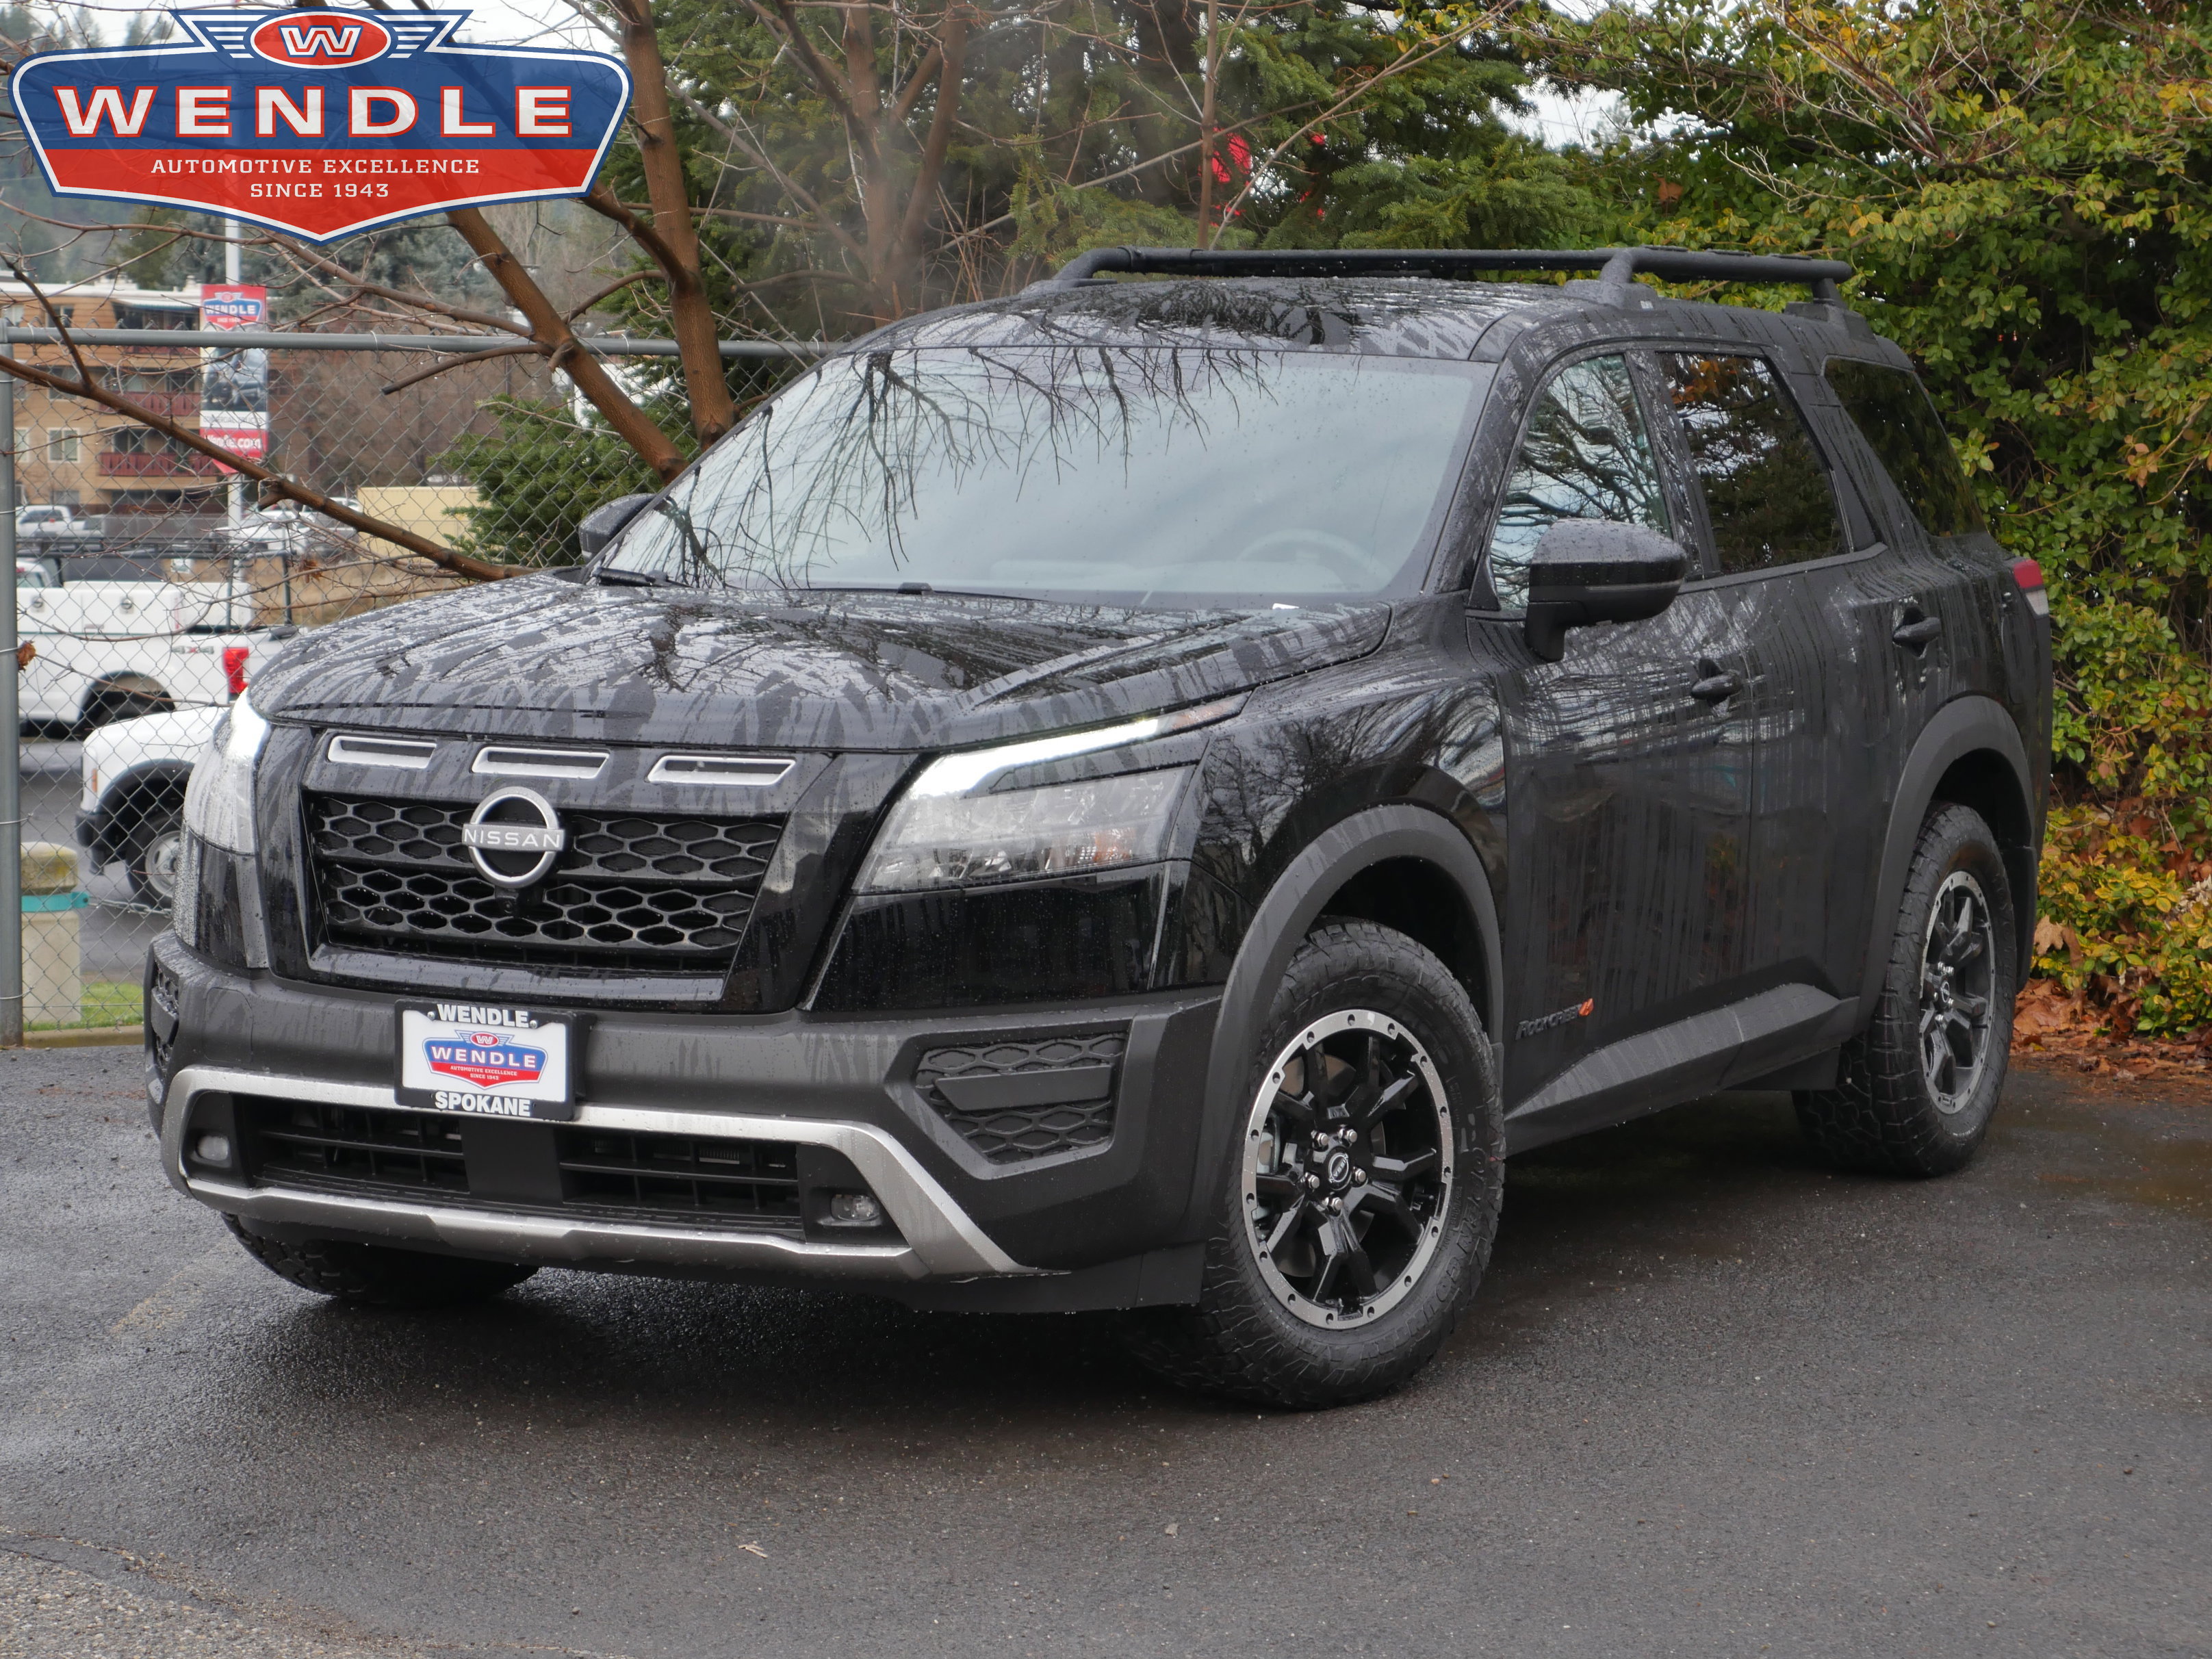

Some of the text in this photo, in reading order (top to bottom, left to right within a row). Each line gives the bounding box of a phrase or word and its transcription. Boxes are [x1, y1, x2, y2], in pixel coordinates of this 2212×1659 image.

[205, 305, 256, 314] WENDLE
[464, 828, 560, 848] NISSAN
[437, 1003, 530, 1029] WENDLE
[430, 1046, 537, 1069] WENDLE
[450, 1065, 517, 1077] AUTOMOTIVE EXCELLENCE
[435, 1090, 531, 1117] SPOKANE
